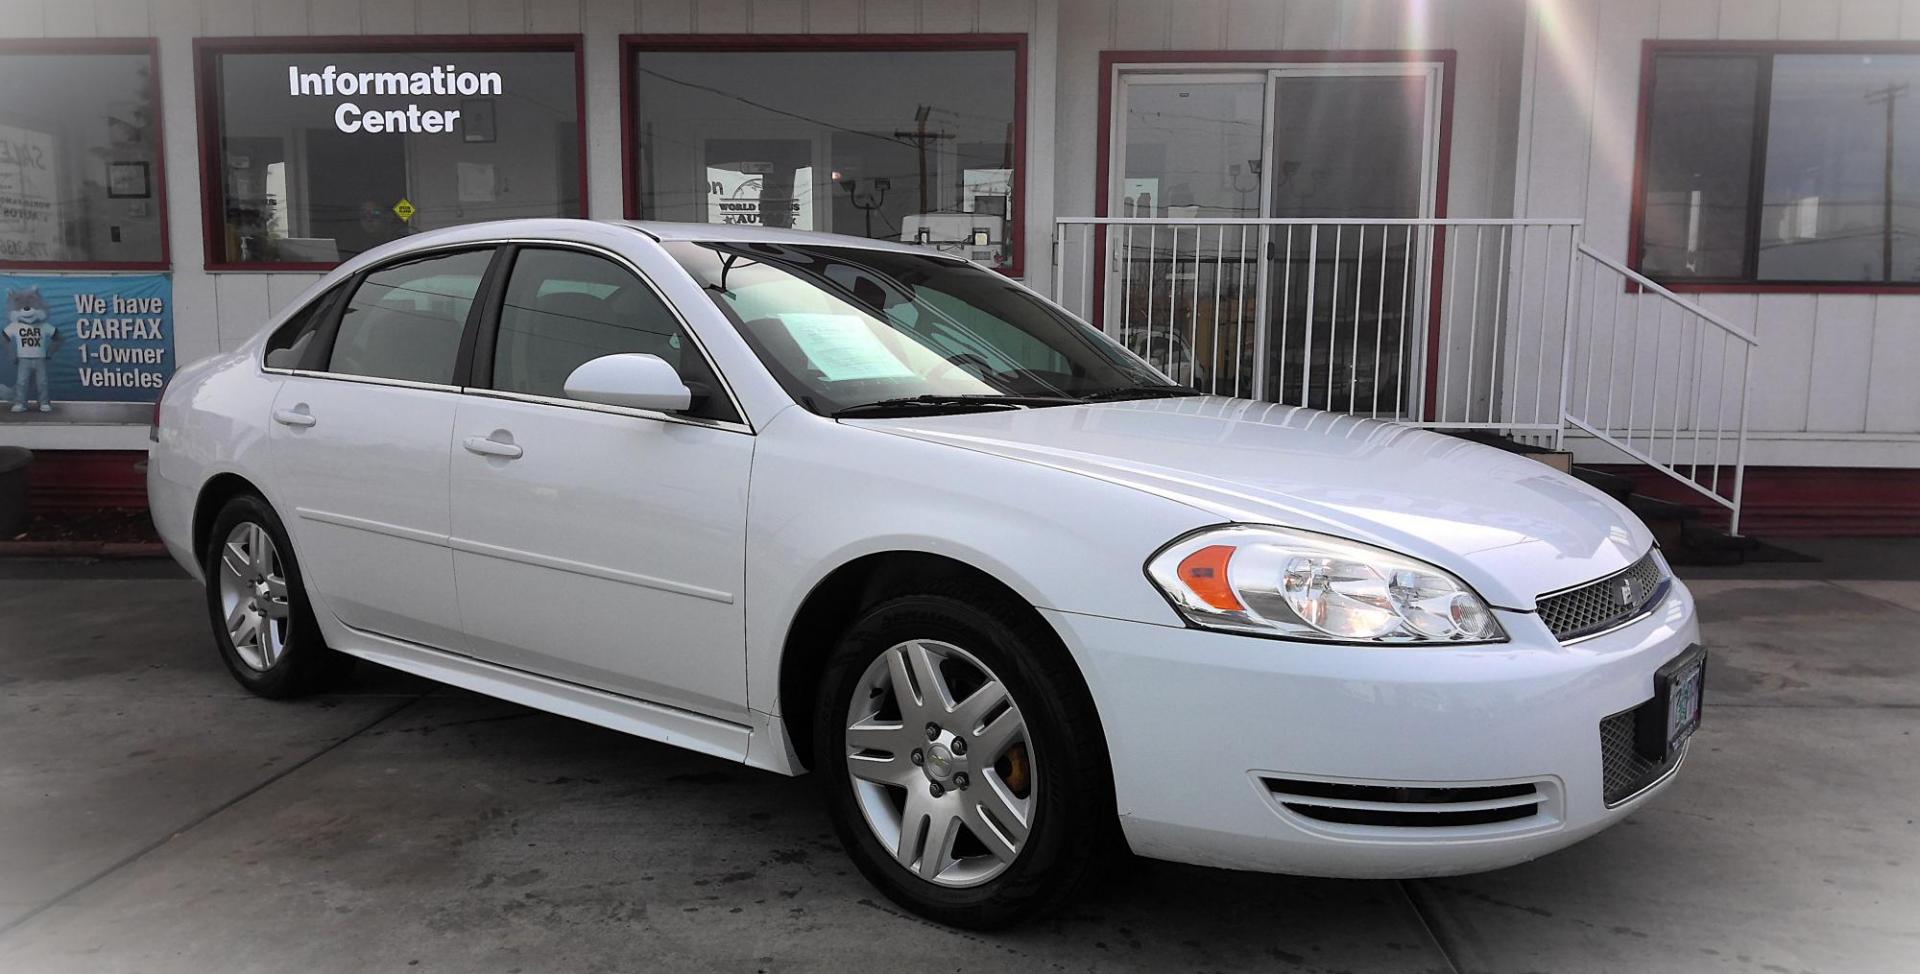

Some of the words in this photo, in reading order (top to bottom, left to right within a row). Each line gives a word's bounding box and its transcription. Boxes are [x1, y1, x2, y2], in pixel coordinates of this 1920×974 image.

[289, 65, 502, 96] Information
[335, 102, 461, 133] Center
[719, 203, 756, 211] WORLD
[74, 294, 106, 314] We
[113, 294, 163, 314] have
[19, 328, 41, 337] CAR
[76, 318, 164, 340] CARFAX
[21, 337, 41, 347] FOX
[78, 343, 165, 364] 1-Owner
[79, 368, 164, 388] Vehicles
